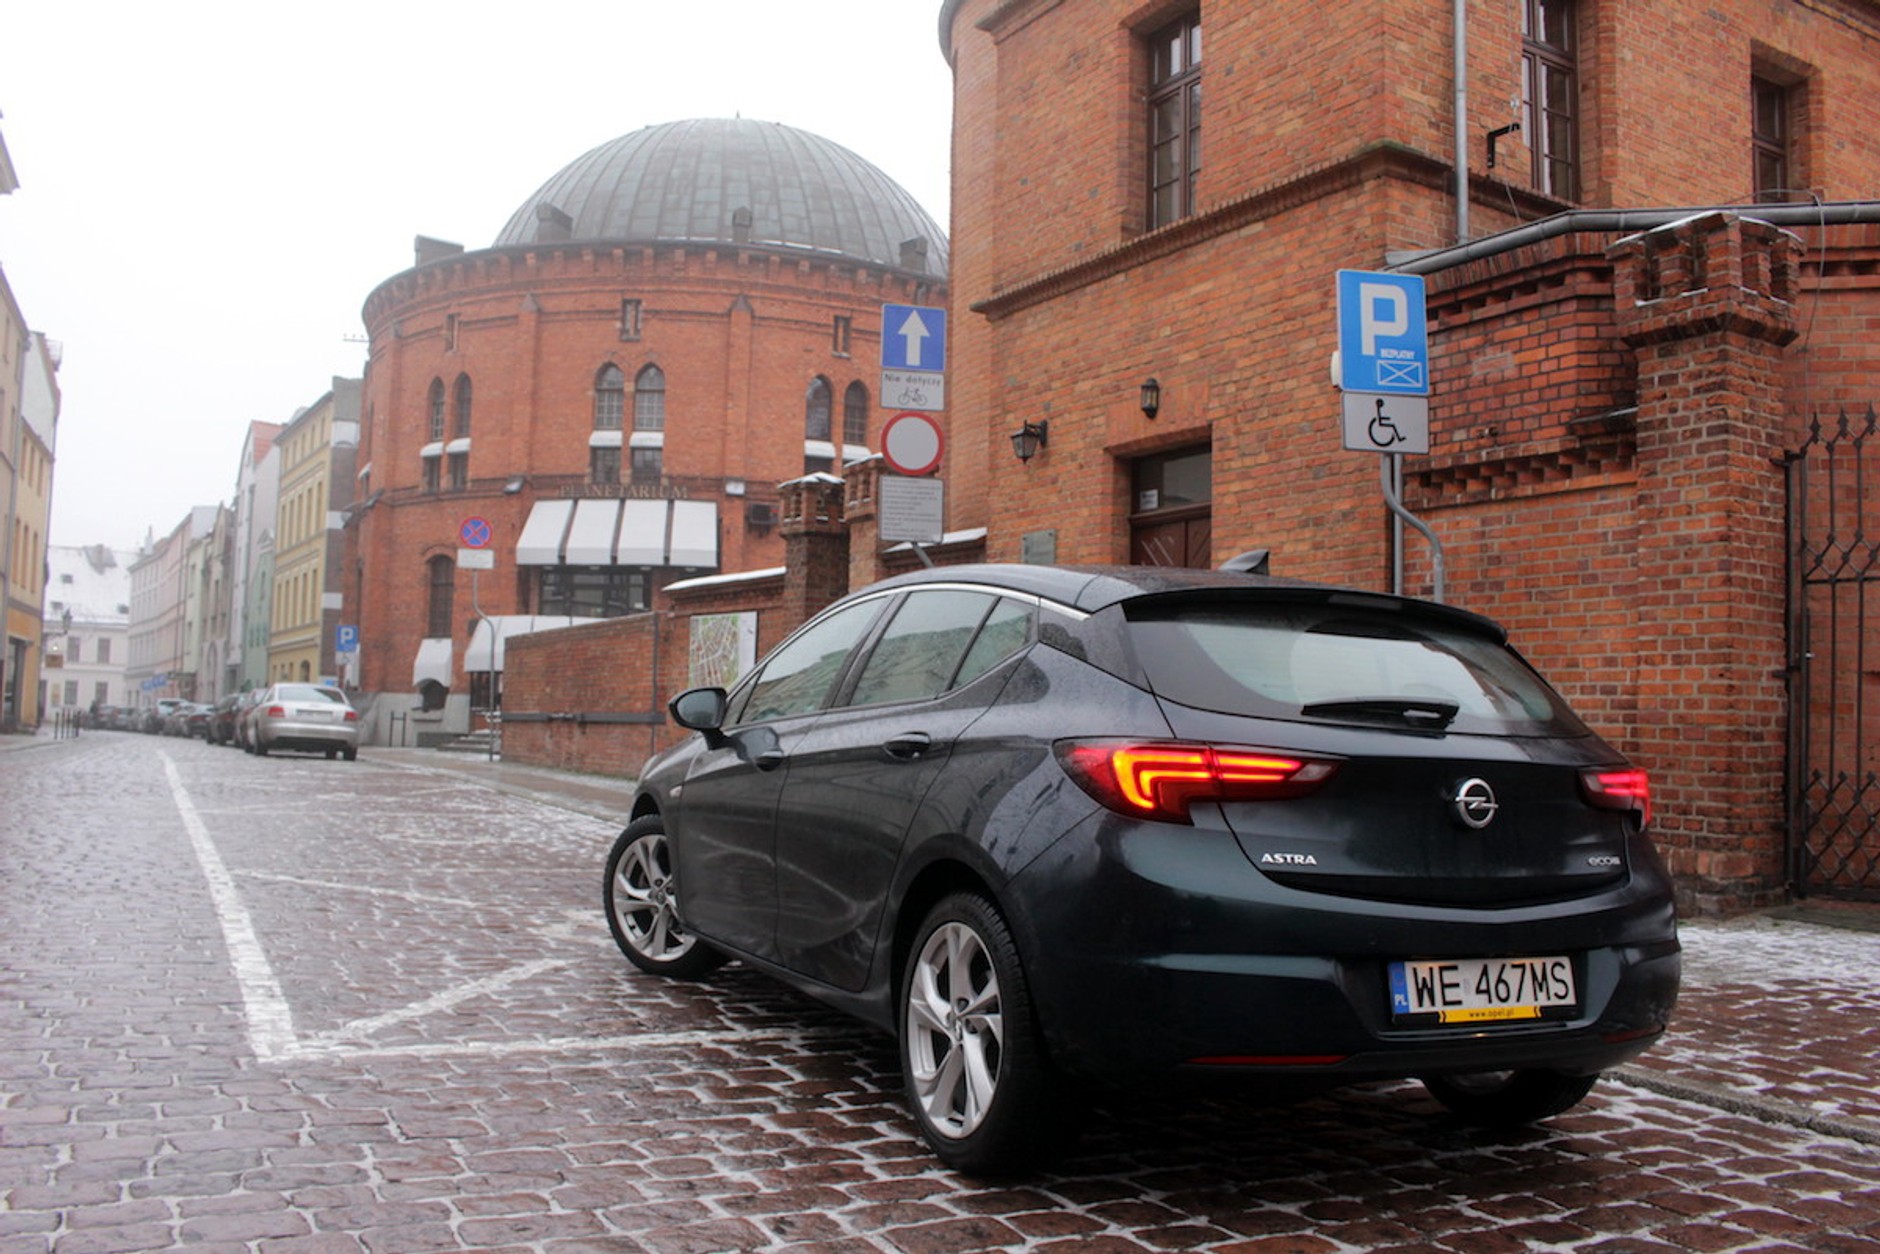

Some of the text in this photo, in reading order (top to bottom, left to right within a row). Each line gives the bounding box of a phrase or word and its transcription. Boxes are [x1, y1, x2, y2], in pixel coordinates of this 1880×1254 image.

[1360, 283, 1408, 356] P
[884, 373, 901, 383] Nie
[560, 484, 688, 499] PLANETARIUM
[1261, 853, 1317, 865] ASTRA
[1413, 961, 1569, 1008] WE 467MS
[1394, 993, 1408, 1007] PL
